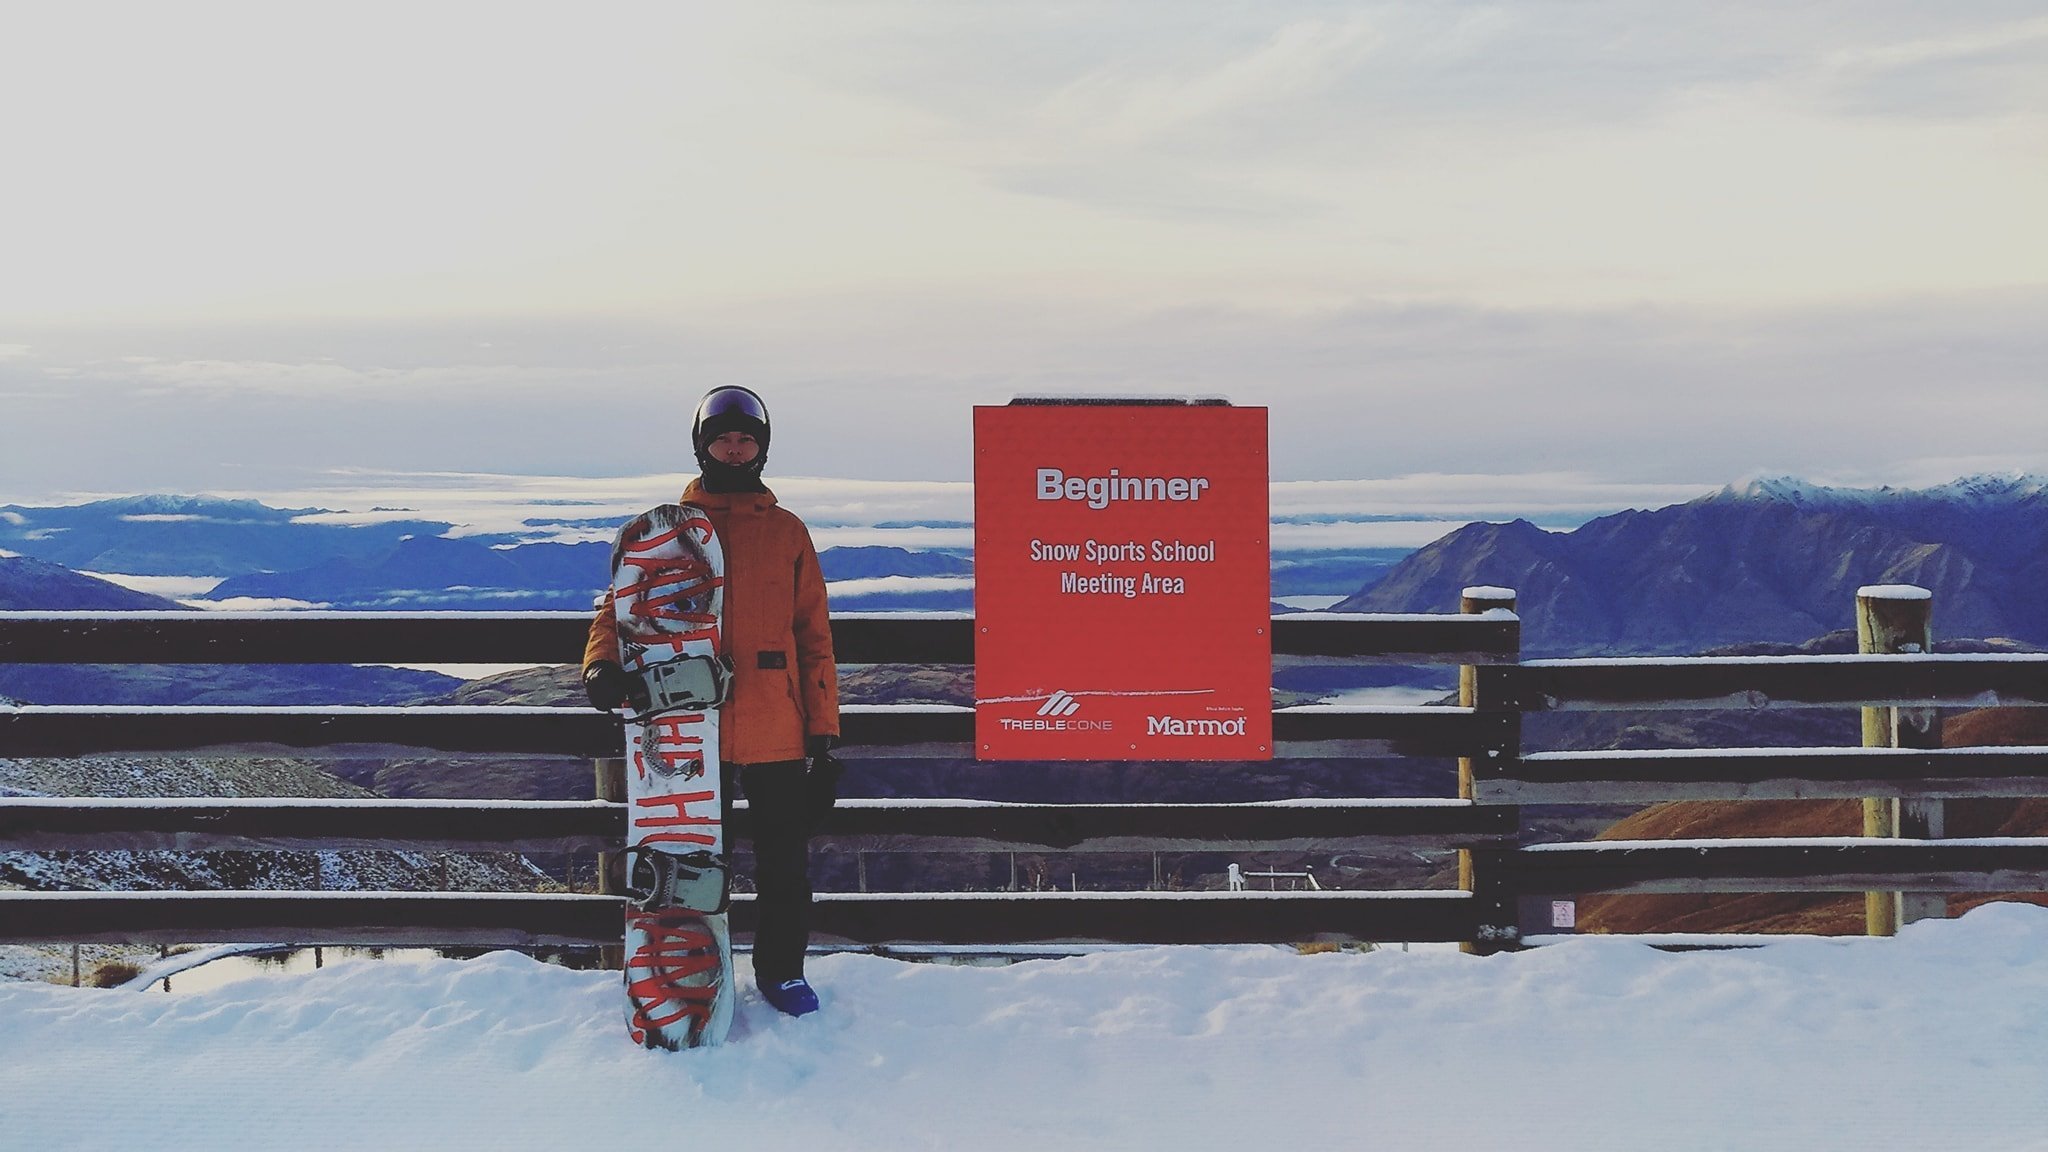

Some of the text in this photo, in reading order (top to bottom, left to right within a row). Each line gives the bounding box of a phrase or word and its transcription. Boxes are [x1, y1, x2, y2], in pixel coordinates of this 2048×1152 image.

[1037, 468, 1209, 510] Beginner
[1030, 539, 1215, 566] Snow Sports School
[615, 517, 724, 670] SAVE
[1061, 572, 1185, 598] Meeting Area
[999, 718, 1112, 731] TREBLECONE
[1146, 716, 1247, 736] Marmot
[622, 702, 705, 780] HE
